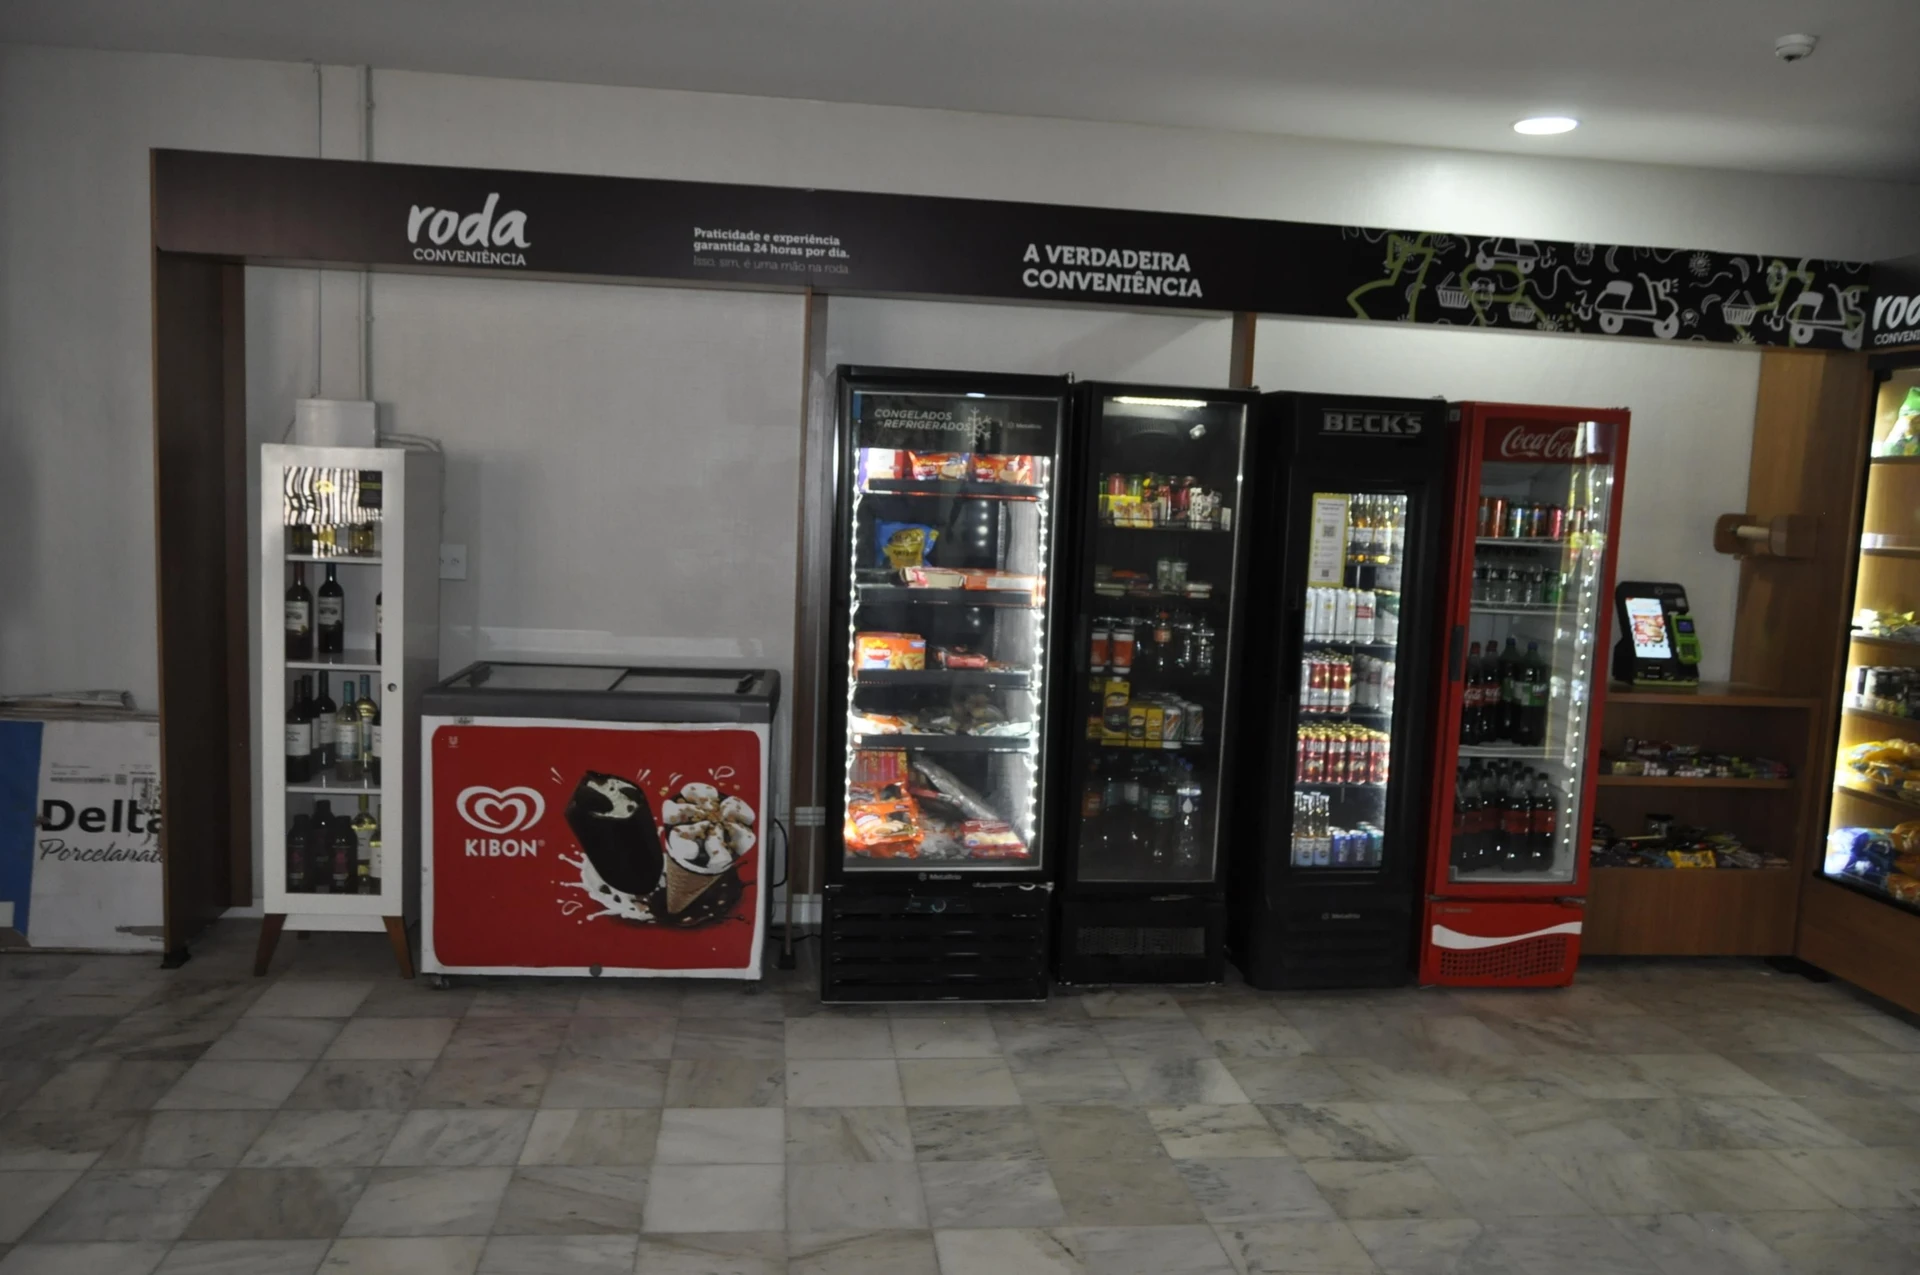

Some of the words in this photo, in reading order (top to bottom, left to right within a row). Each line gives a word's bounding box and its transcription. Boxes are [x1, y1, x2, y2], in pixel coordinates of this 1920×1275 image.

[407, 193, 531, 248] roda
[693, 226, 761, 242] Praticidade
[763, 234, 771, 243] e
[772, 233, 841, 247] experiência
[413, 248, 527, 267] CONVENIÊNCIA
[693, 241, 751, 254] garantida
[753, 242, 768, 254] 24
[770, 243, 802, 256] horas
[805, 247, 826, 259] por
[828, 247, 851, 259] dia.
[1023, 243, 1041, 264] A
[1045, 244, 1191, 273] VERDADEIRA
[753, 261, 778, 271] uma
[780, 260, 806, 272] mão
[808, 263, 822, 273] na
[1022, 269, 1203, 298] CONVENIÊNCIA
[874, 408, 953, 421] CONGELADOS
[1323, 411, 1423, 435] BECK'S
[883, 419, 971, 432] REFRIGERADOS
[465, 838, 538, 858] KIBON
